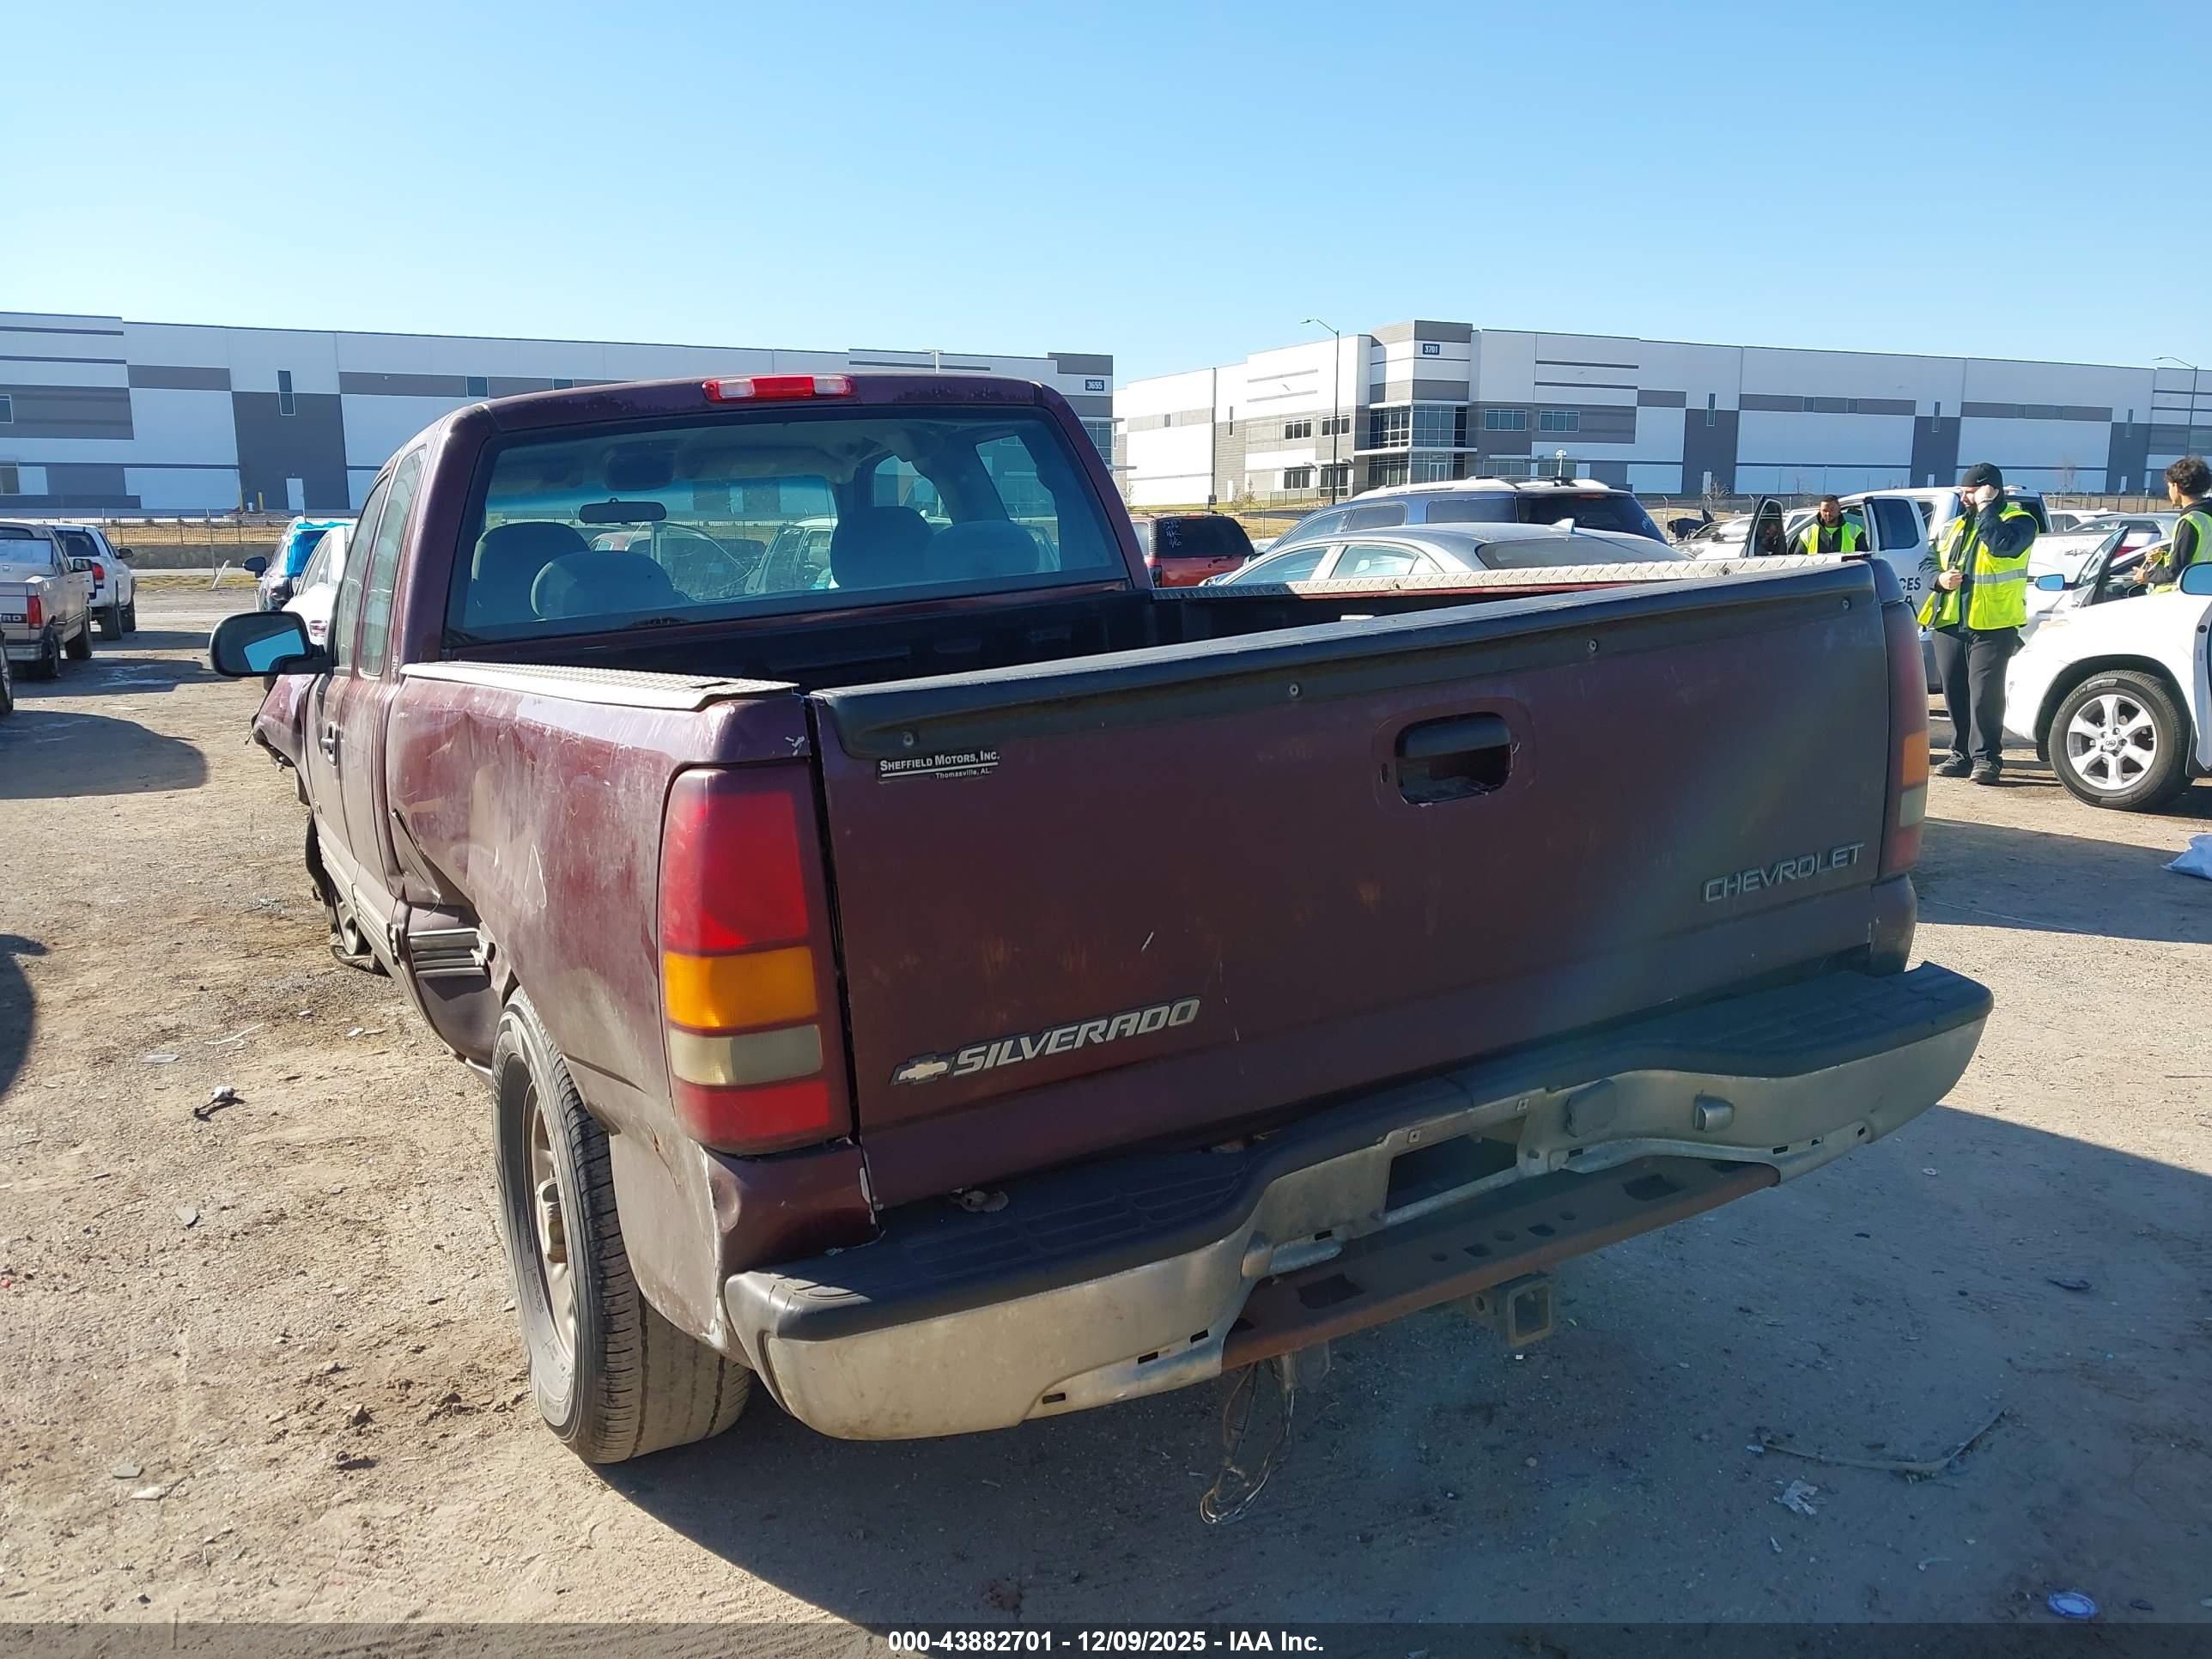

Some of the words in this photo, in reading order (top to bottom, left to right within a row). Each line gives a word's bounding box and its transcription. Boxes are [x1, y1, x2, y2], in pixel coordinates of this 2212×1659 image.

[1087, 380, 1103, 390] 3655
[879, 757, 933, 771] SHEFFIELD
[935, 769, 980, 780] Thomasville,
[1705, 842, 1865, 902] CHEVROLET
[953, 998, 1201, 1076] SILVERADO
